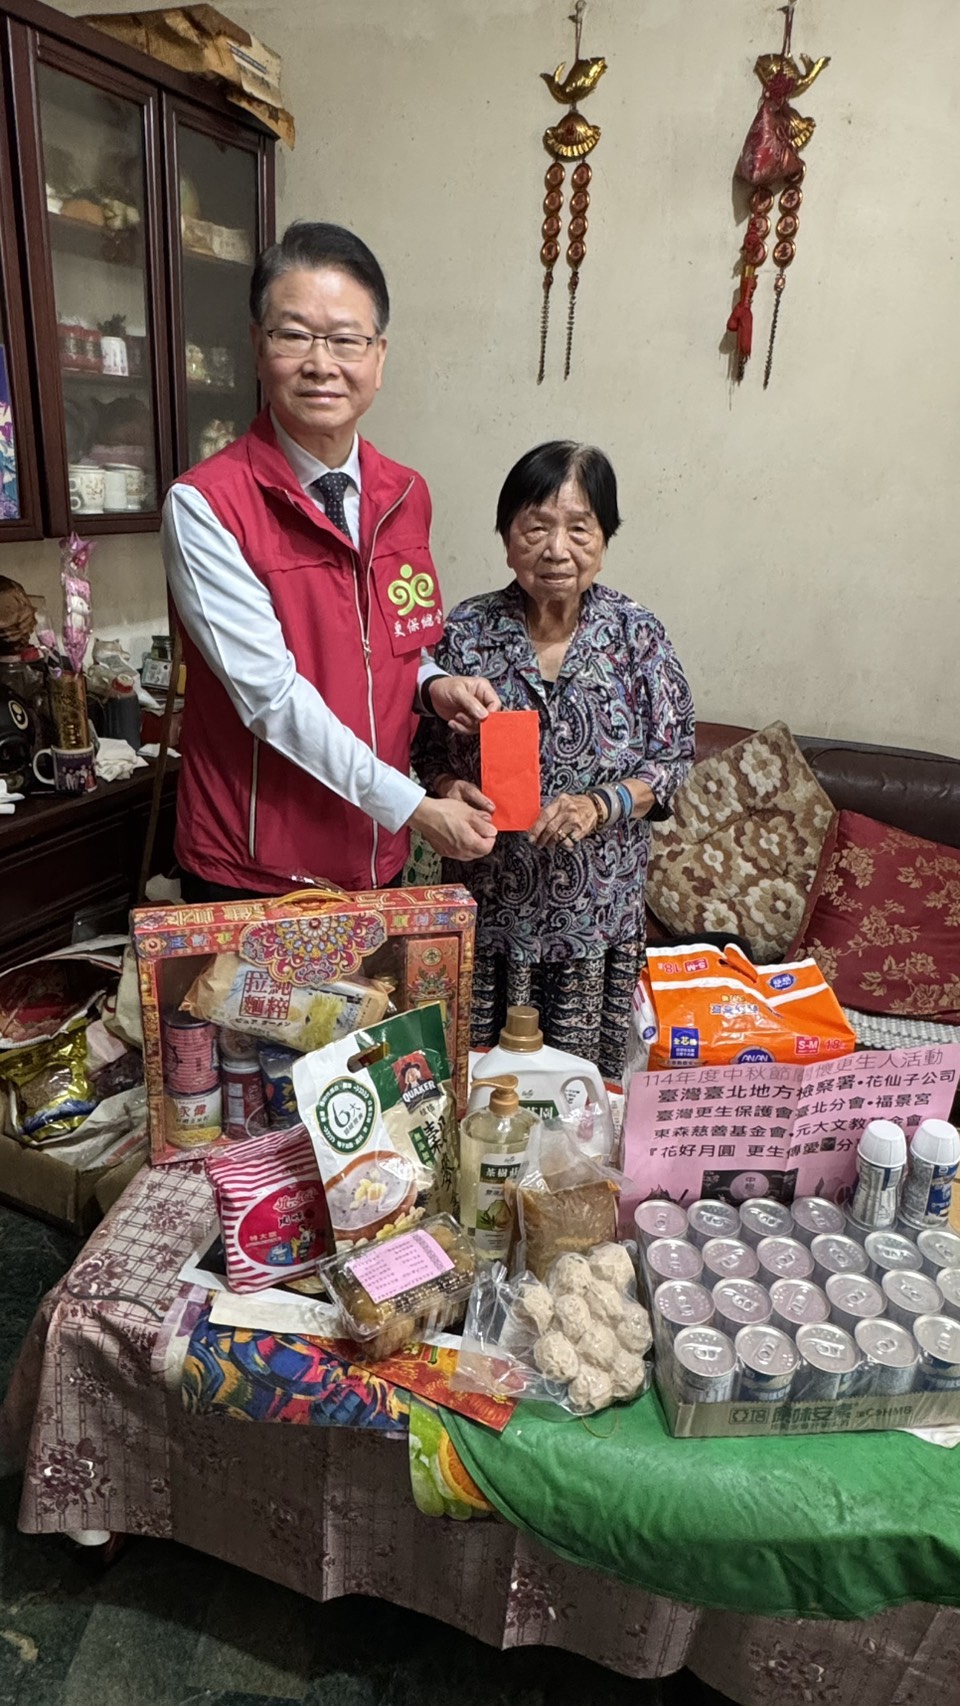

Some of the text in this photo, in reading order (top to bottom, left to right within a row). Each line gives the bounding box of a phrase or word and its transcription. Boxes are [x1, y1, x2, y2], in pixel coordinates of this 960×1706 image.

[798, 1040, 818, 1050] S-M
[742, 1054, 769, 1062] ANAN
[402, 1079, 436, 1103] QUAKER
